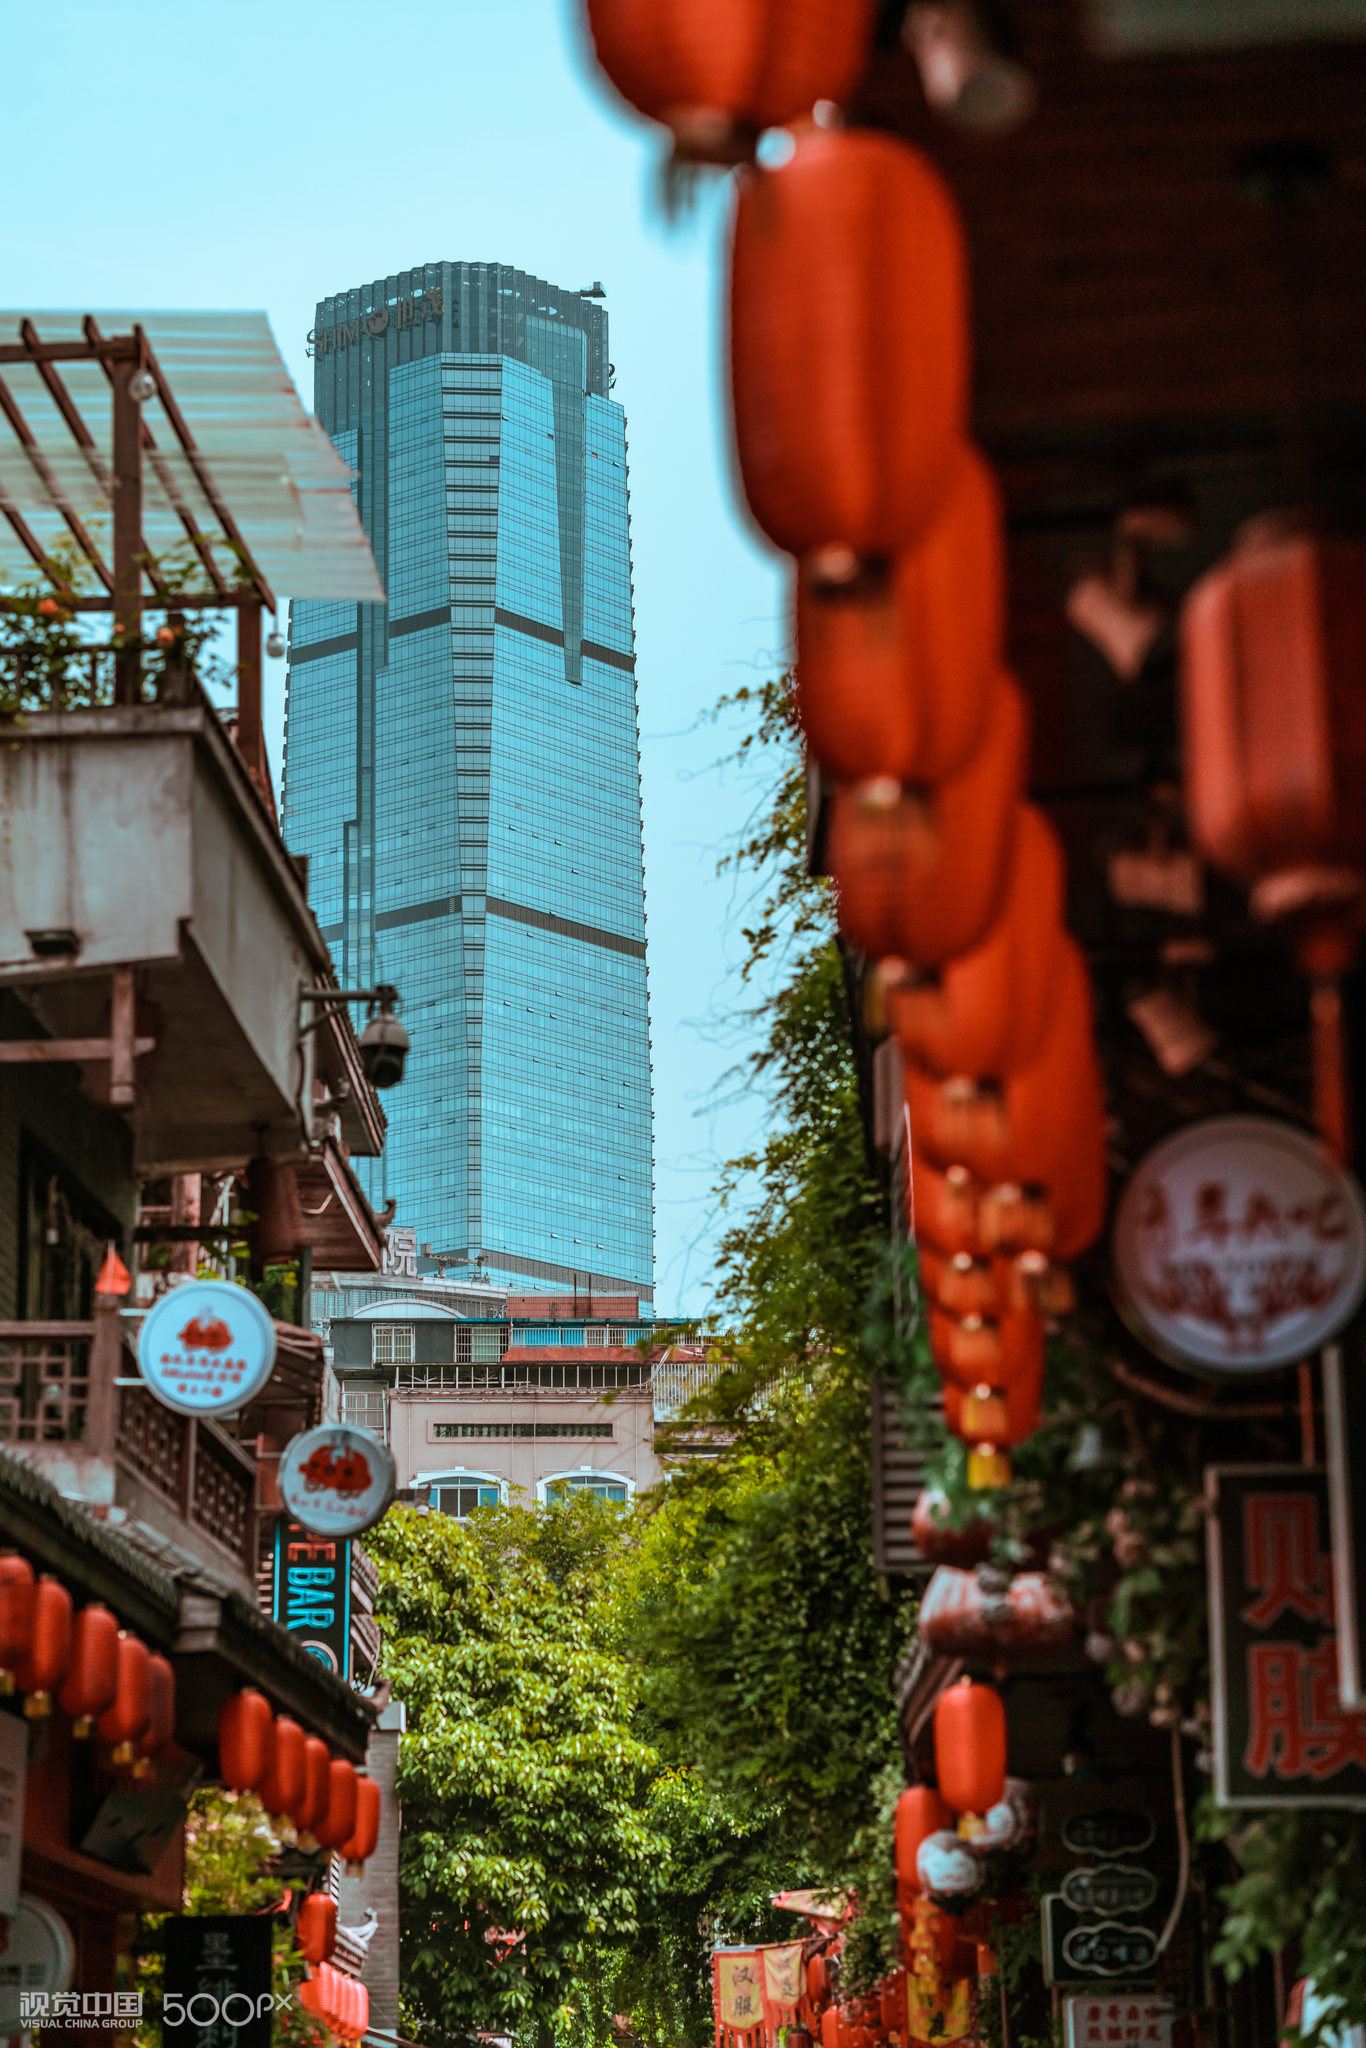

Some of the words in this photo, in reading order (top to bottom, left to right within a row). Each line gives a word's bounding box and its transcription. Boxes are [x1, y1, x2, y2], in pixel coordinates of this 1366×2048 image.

[383, 1231, 417, 1278] 院
[287, 1567, 335, 1630] BAR
[732, 1965, 755, 2016] 汉服
